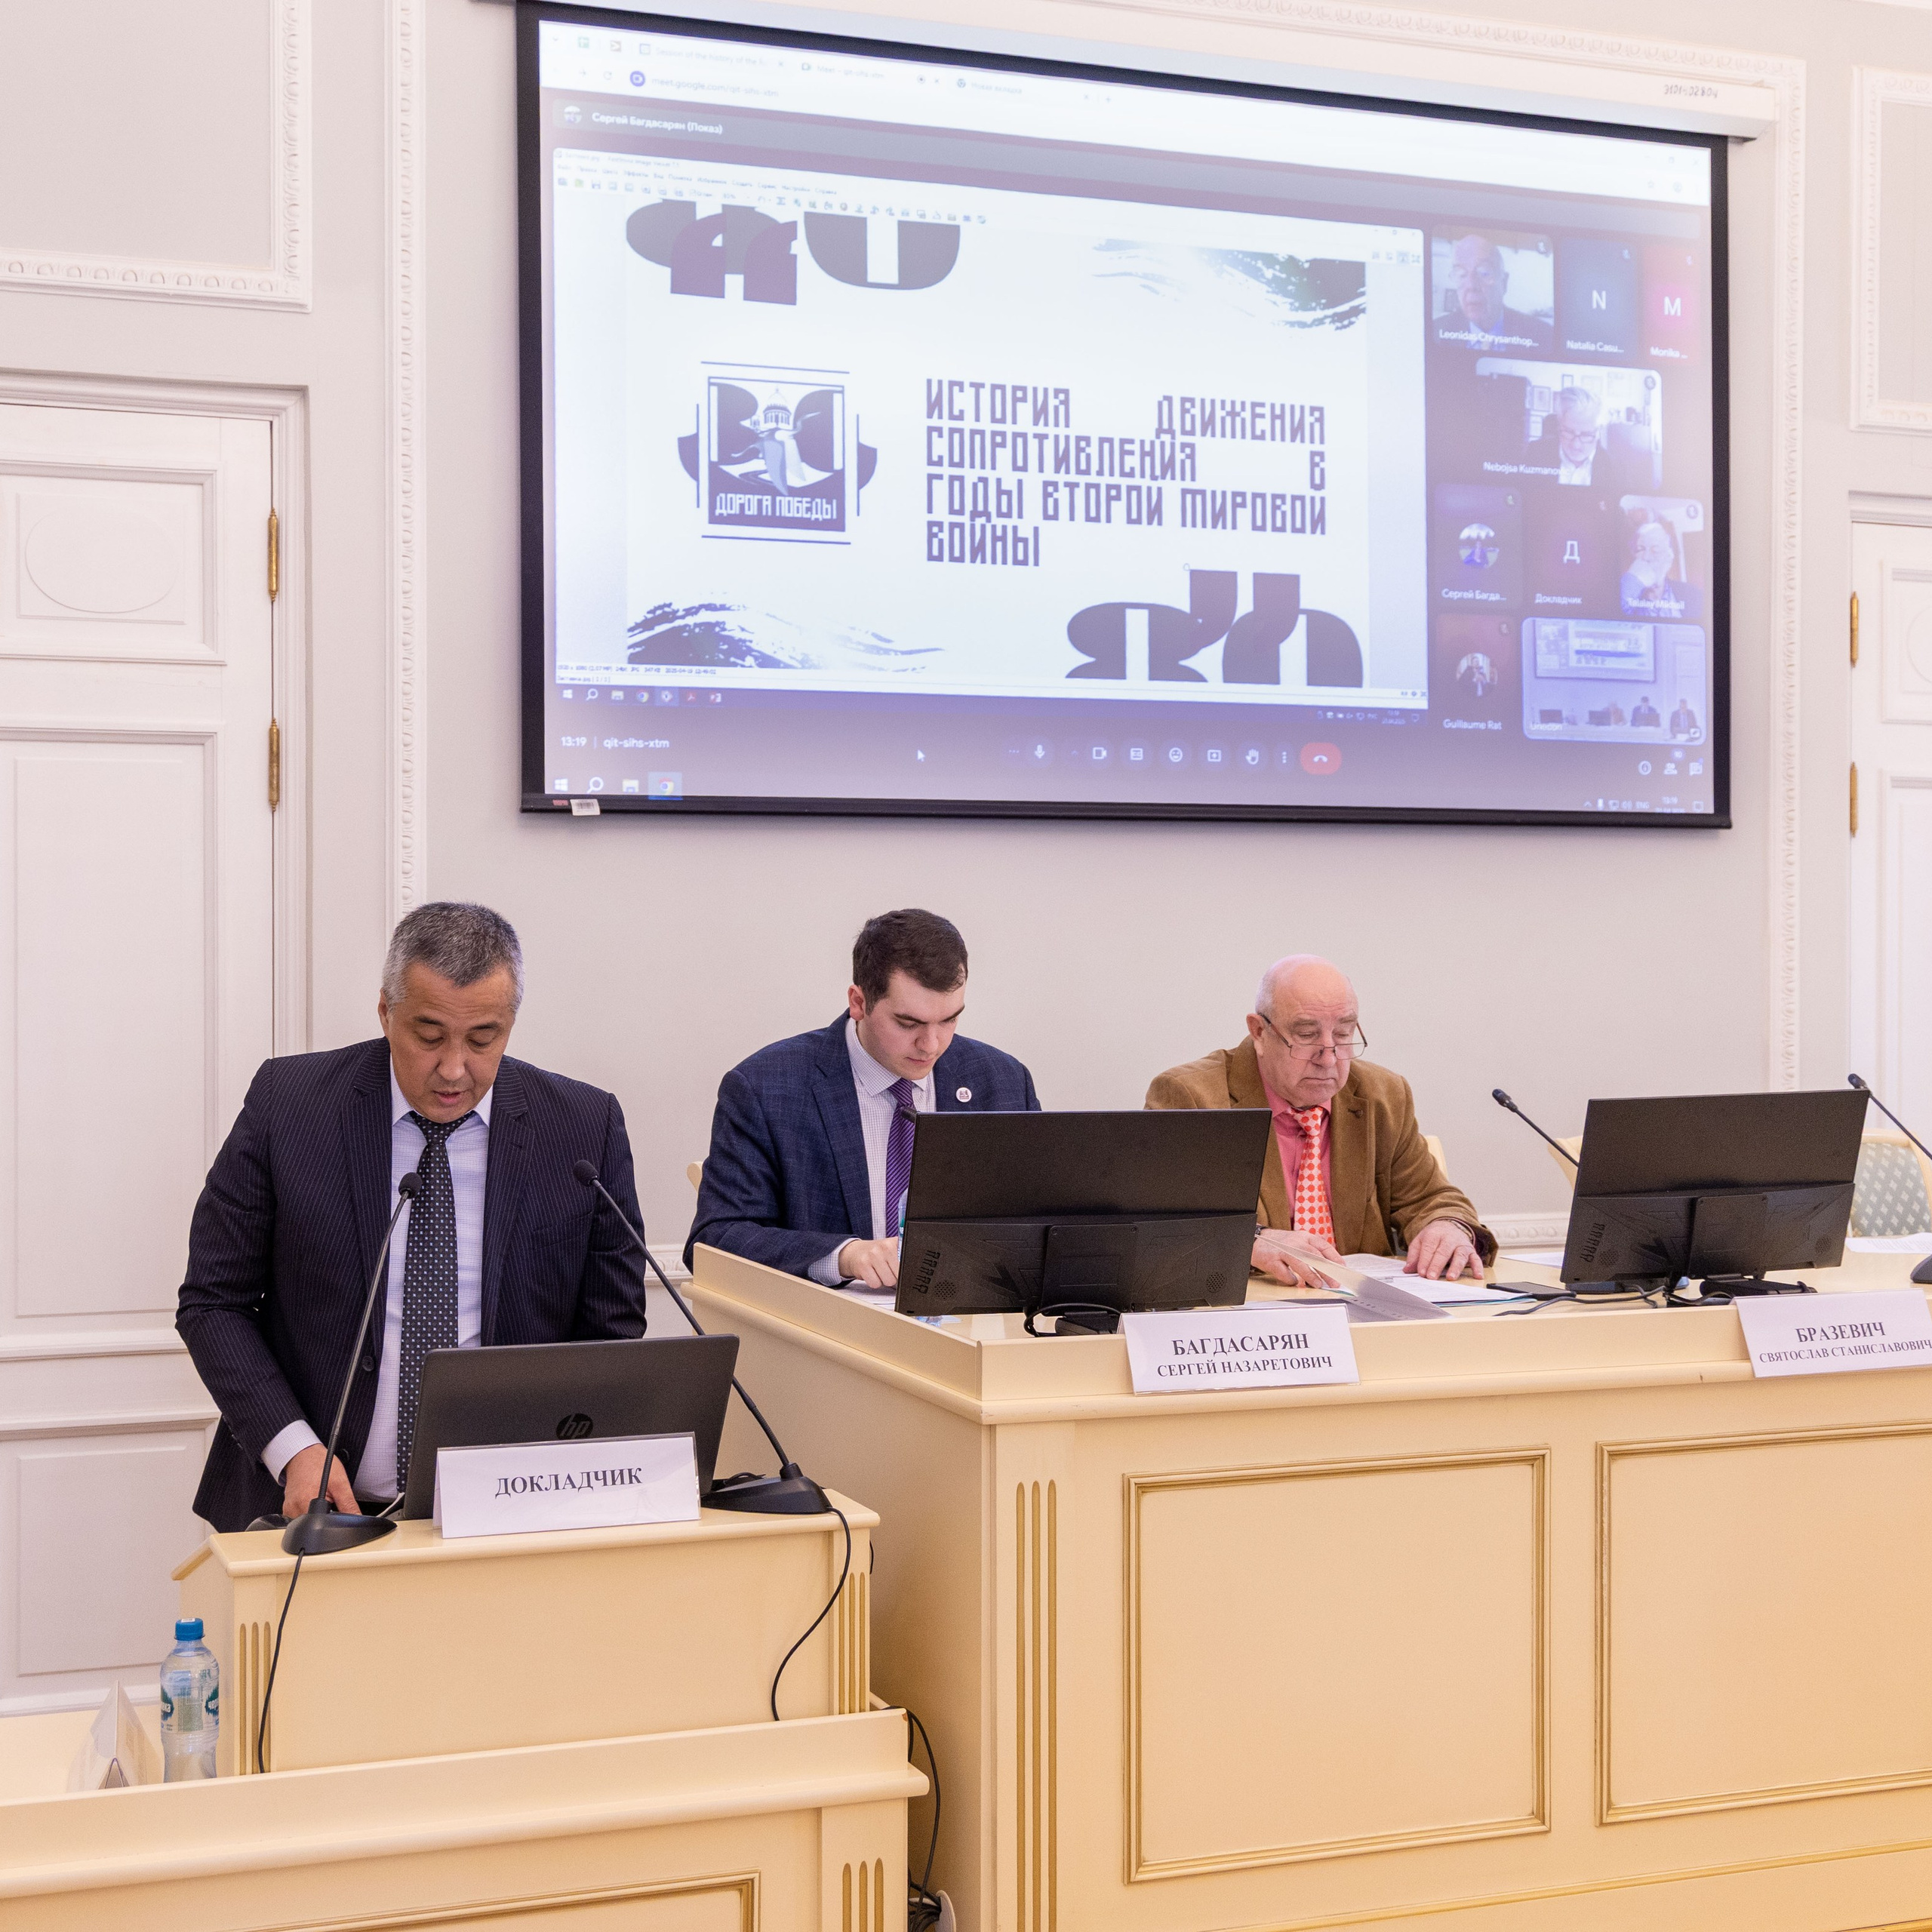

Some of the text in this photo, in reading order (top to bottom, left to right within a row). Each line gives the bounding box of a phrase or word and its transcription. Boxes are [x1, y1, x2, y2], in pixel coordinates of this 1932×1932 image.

[592, 112, 723, 135] Сергей Багдасарян (Показ)
[1592, 290, 1606, 310] N
[1663, 296, 1682, 317] M
[1566, 340, 1595, 350] Natalia
[926, 378, 1325, 445] ИСТОРИЯ ДВИЖЕНИЯ
[927, 425, 1196, 481] СОПРОТИВЛЕНИЯ
[715, 493, 837, 521] ДОРОГА ПОБЕДЫ
[927, 473, 1326, 536] ГОДЫ ВТОРОЙ МИРОВОЙ
[927, 518, 1039, 567] ВОЙНЫ
[1562, 540, 1581, 565] Д
[1441, 589, 1474, 600] Сергей
[1535, 593, 1582, 605] Докладчик
[561, 736, 587, 748] 13:19
[1795, 1321, 1886, 1343] БРАЗЕВИЧ
[1171, 1334, 1310, 1357] БАГДАСАРЯН
[1759, 1339, 1932, 1364] СВЯТОСЛАВ СТАНИСЛАВОВИЧ
[1157, 1356, 1333, 1377] СЕРГЕЙ НАЗАРЕТОВИЧ
[560, 1413, 590, 1439] hp
[494, 1467, 642, 1499] ДОКЛАДЧИК
